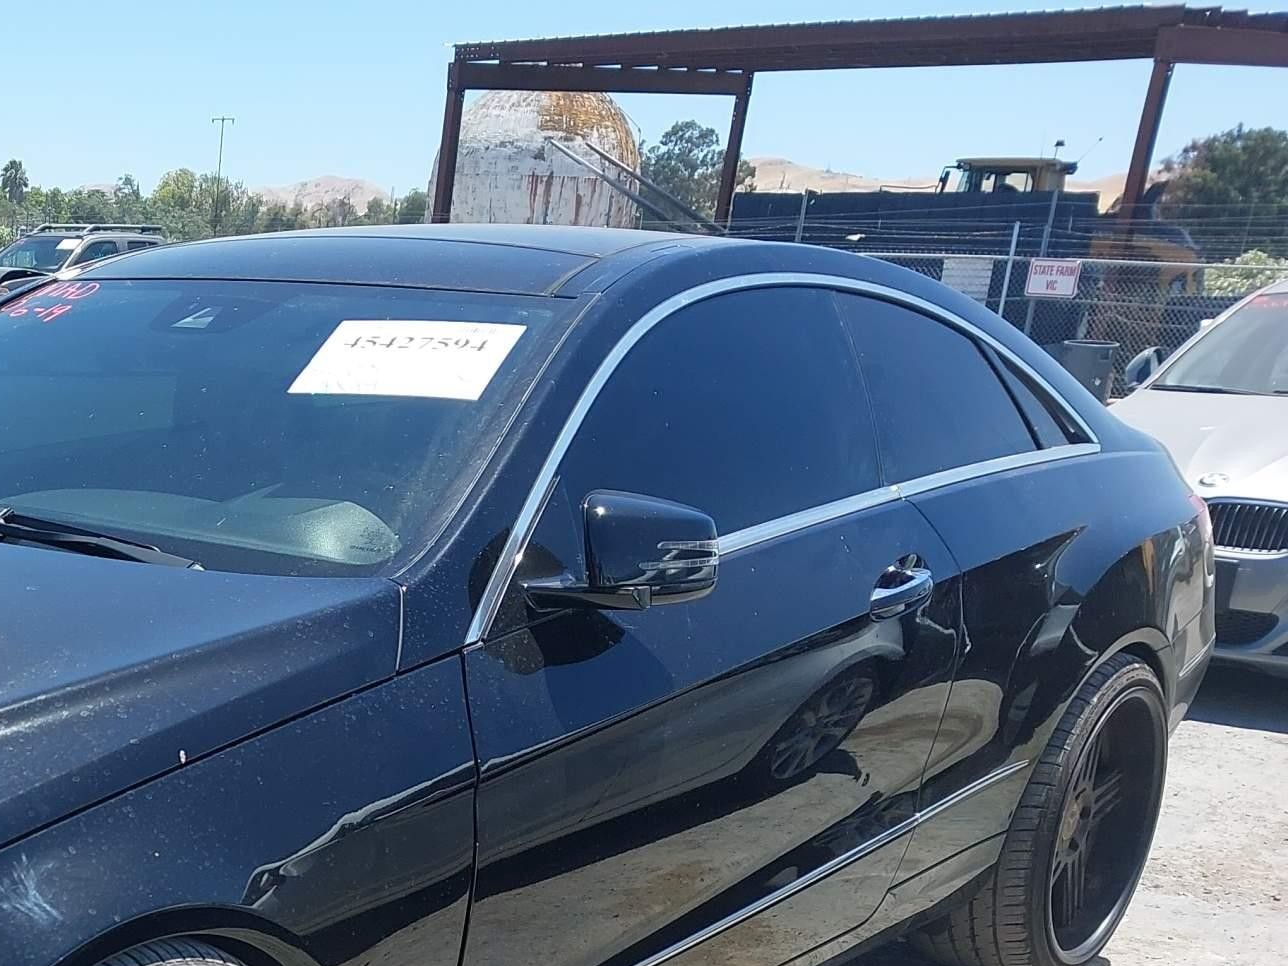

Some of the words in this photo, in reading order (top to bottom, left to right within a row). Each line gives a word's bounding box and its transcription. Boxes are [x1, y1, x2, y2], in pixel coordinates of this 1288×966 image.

[1033, 264, 1055, 276] STATE
[1055, 265, 1077, 277] FARM
[1046, 279, 1058, 291] VIC
[343, 336, 488, 352] 45427594
